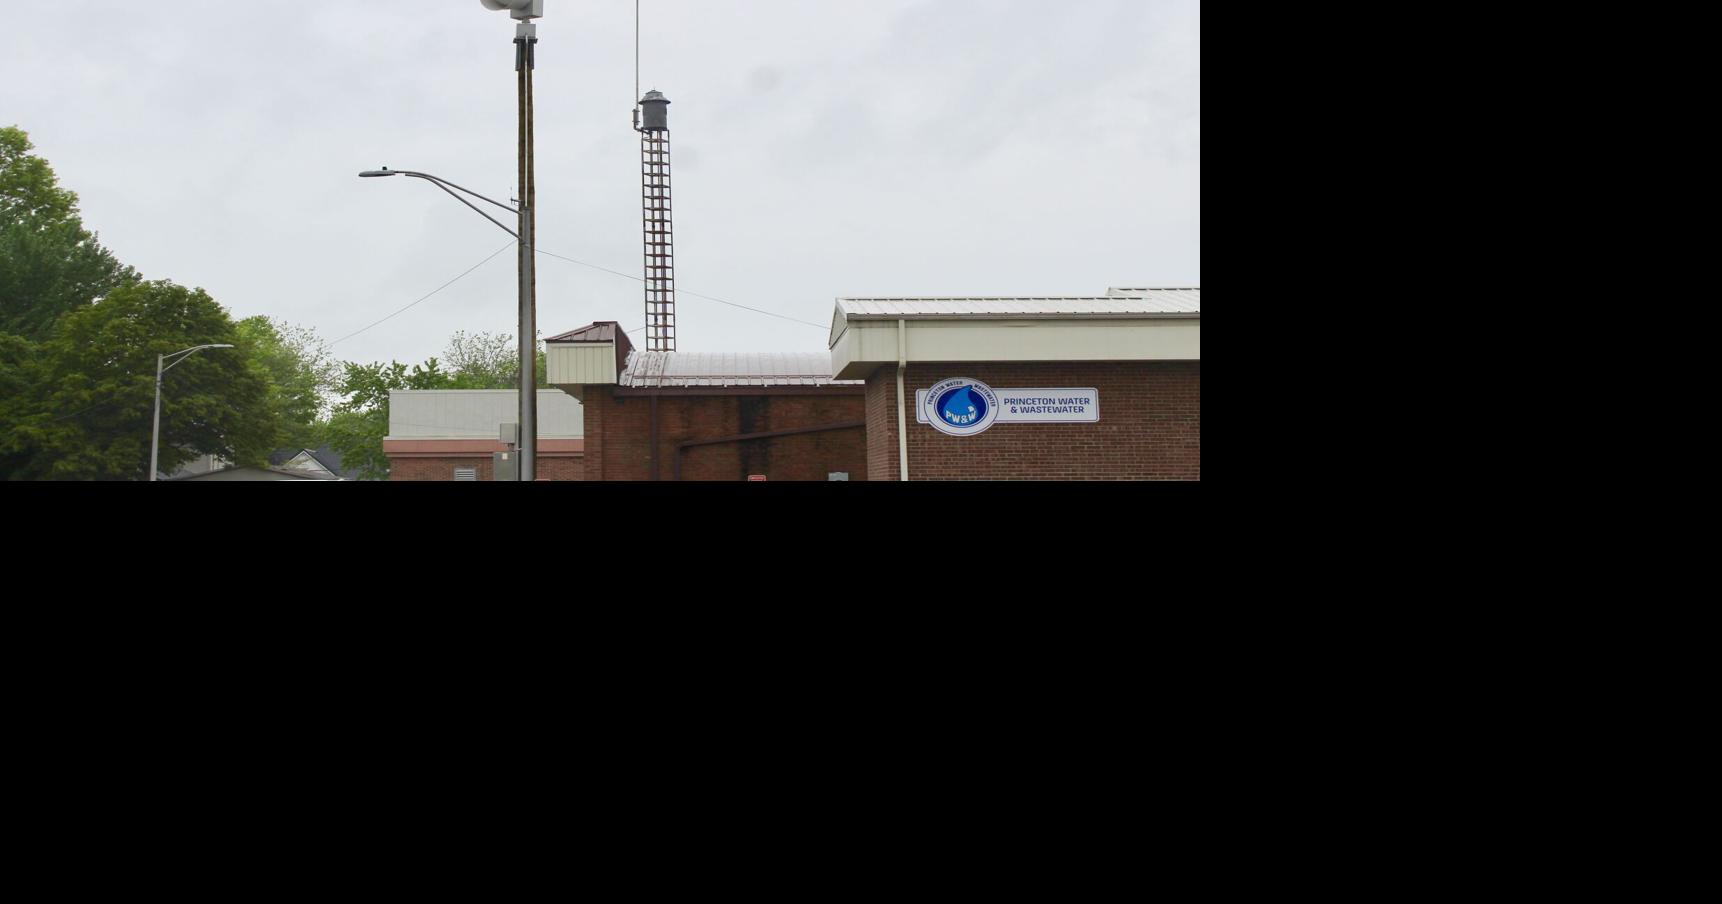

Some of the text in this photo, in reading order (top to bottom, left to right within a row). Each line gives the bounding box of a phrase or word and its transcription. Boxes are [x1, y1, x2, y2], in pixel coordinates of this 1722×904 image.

[1004, 397, 1090, 405] PRINCETON WATER
[1010, 406, 1085, 414] & WASTEWATER
[945, 410, 977, 424] PW&W
